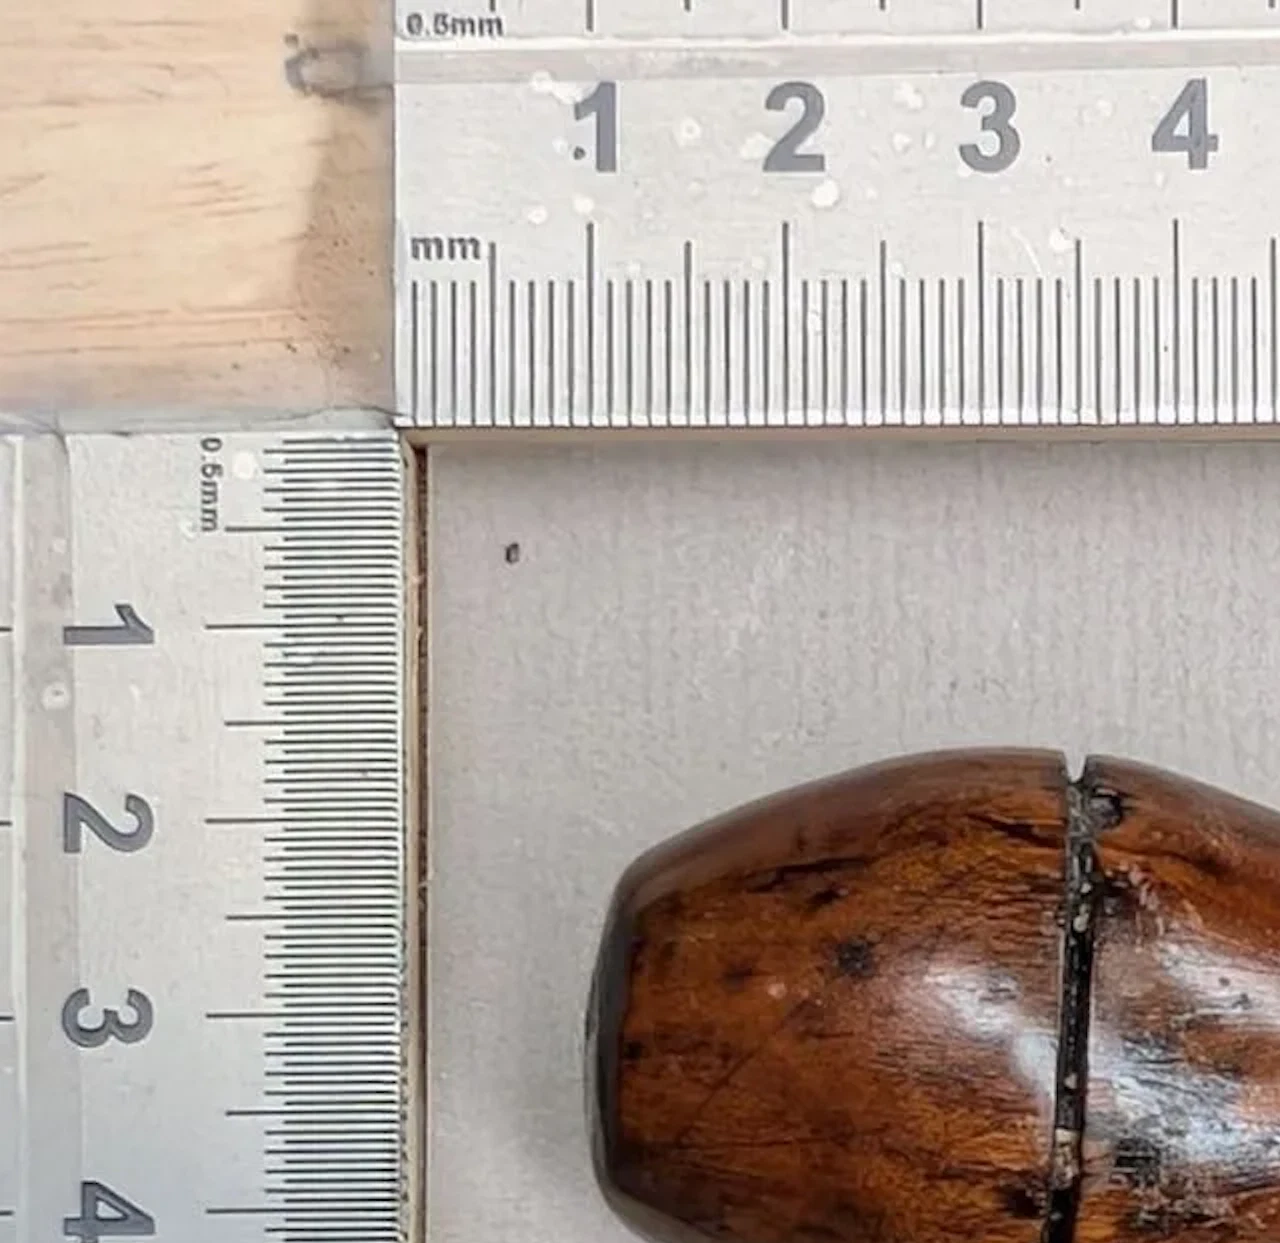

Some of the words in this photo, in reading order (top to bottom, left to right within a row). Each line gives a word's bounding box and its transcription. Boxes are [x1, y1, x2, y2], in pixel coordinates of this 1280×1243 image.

[405, 13, 503, 38] 0.5mm
[573, 81, 618, 174] 1
[763, 81, 826, 173] 2
[958, 80, 1021, 173] 3
[1151, 77, 1219, 170] 4
[410, 233, 482, 263] mm
[200, 438, 222, 533] 0.5mm
[63, 604, 155, 646] 1
[63, 792, 155, 854] 2
[61, 988, 154, 1048] 3
